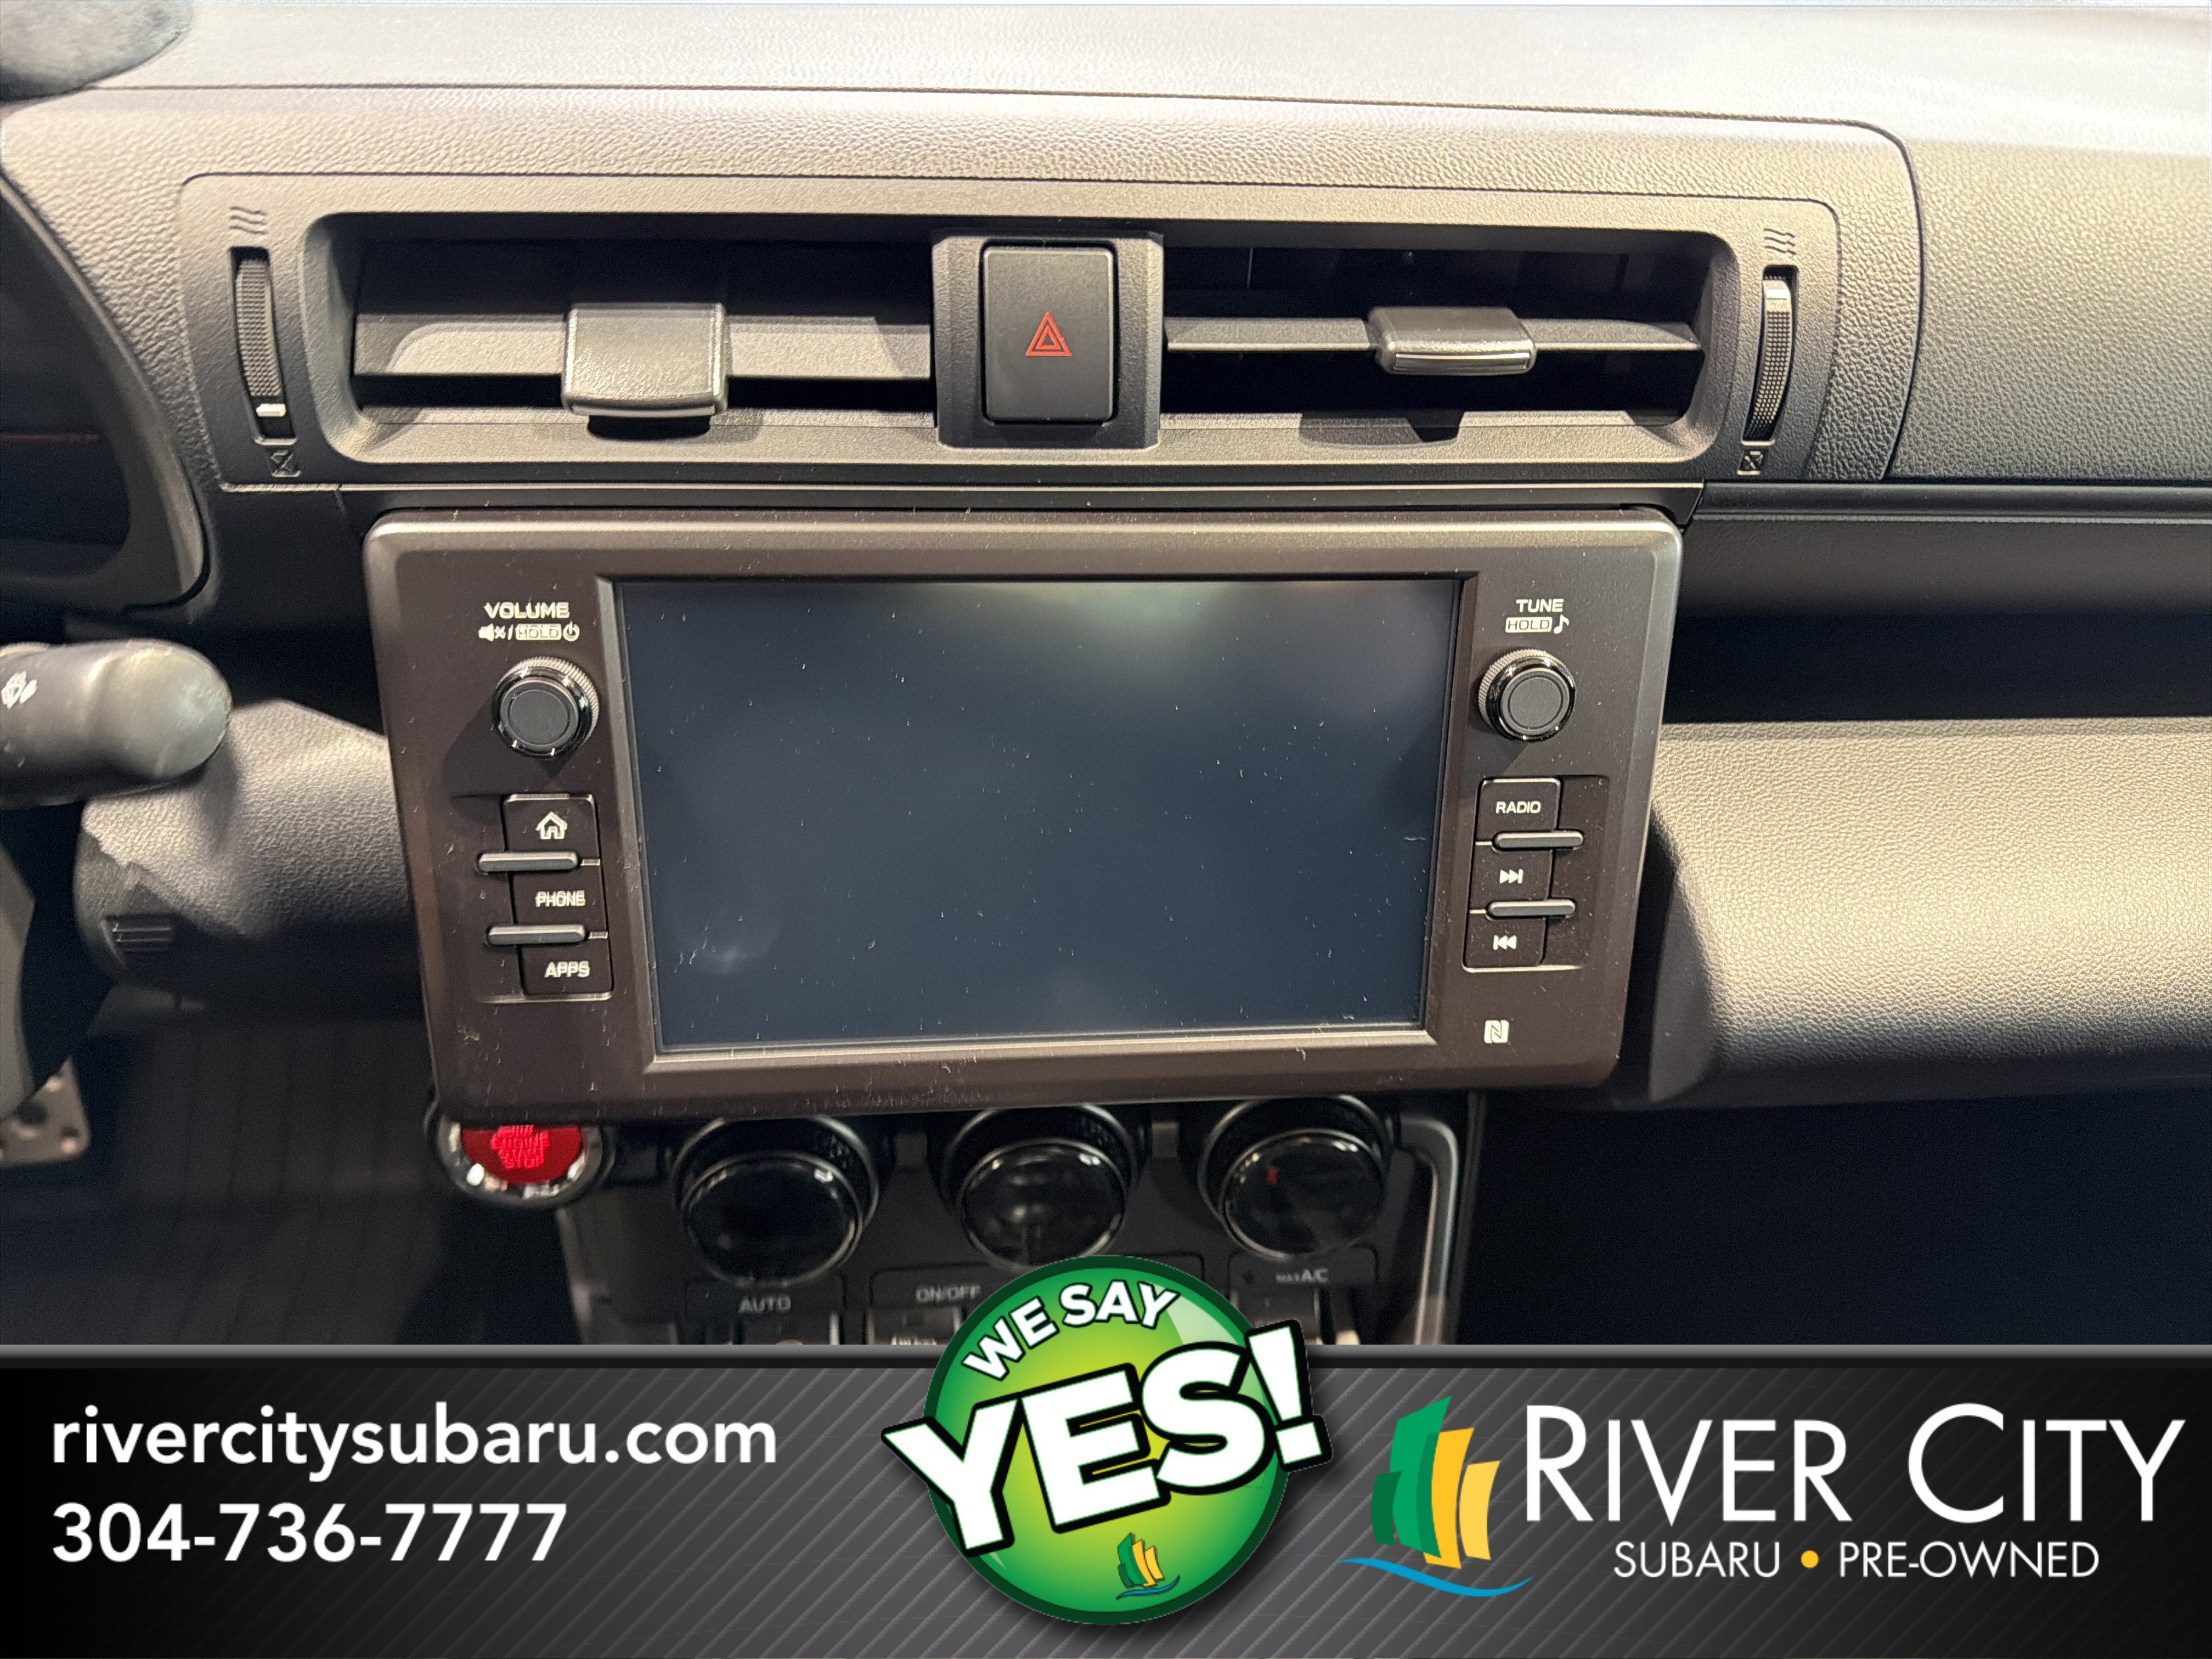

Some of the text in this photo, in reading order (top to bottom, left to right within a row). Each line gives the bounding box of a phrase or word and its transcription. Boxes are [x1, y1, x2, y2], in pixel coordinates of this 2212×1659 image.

[483, 601, 571, 619] VOLUME
[1515, 598, 1564, 613] TUNE
[517, 625, 560, 639] HOLD
[1506, 619, 1551, 631] HOLD
[1496, 800, 1542, 814] RADIO
[535, 890, 586, 907] PHONE
[544, 961, 590, 978] APPS
[738, 1295, 791, 1313] AUTO
